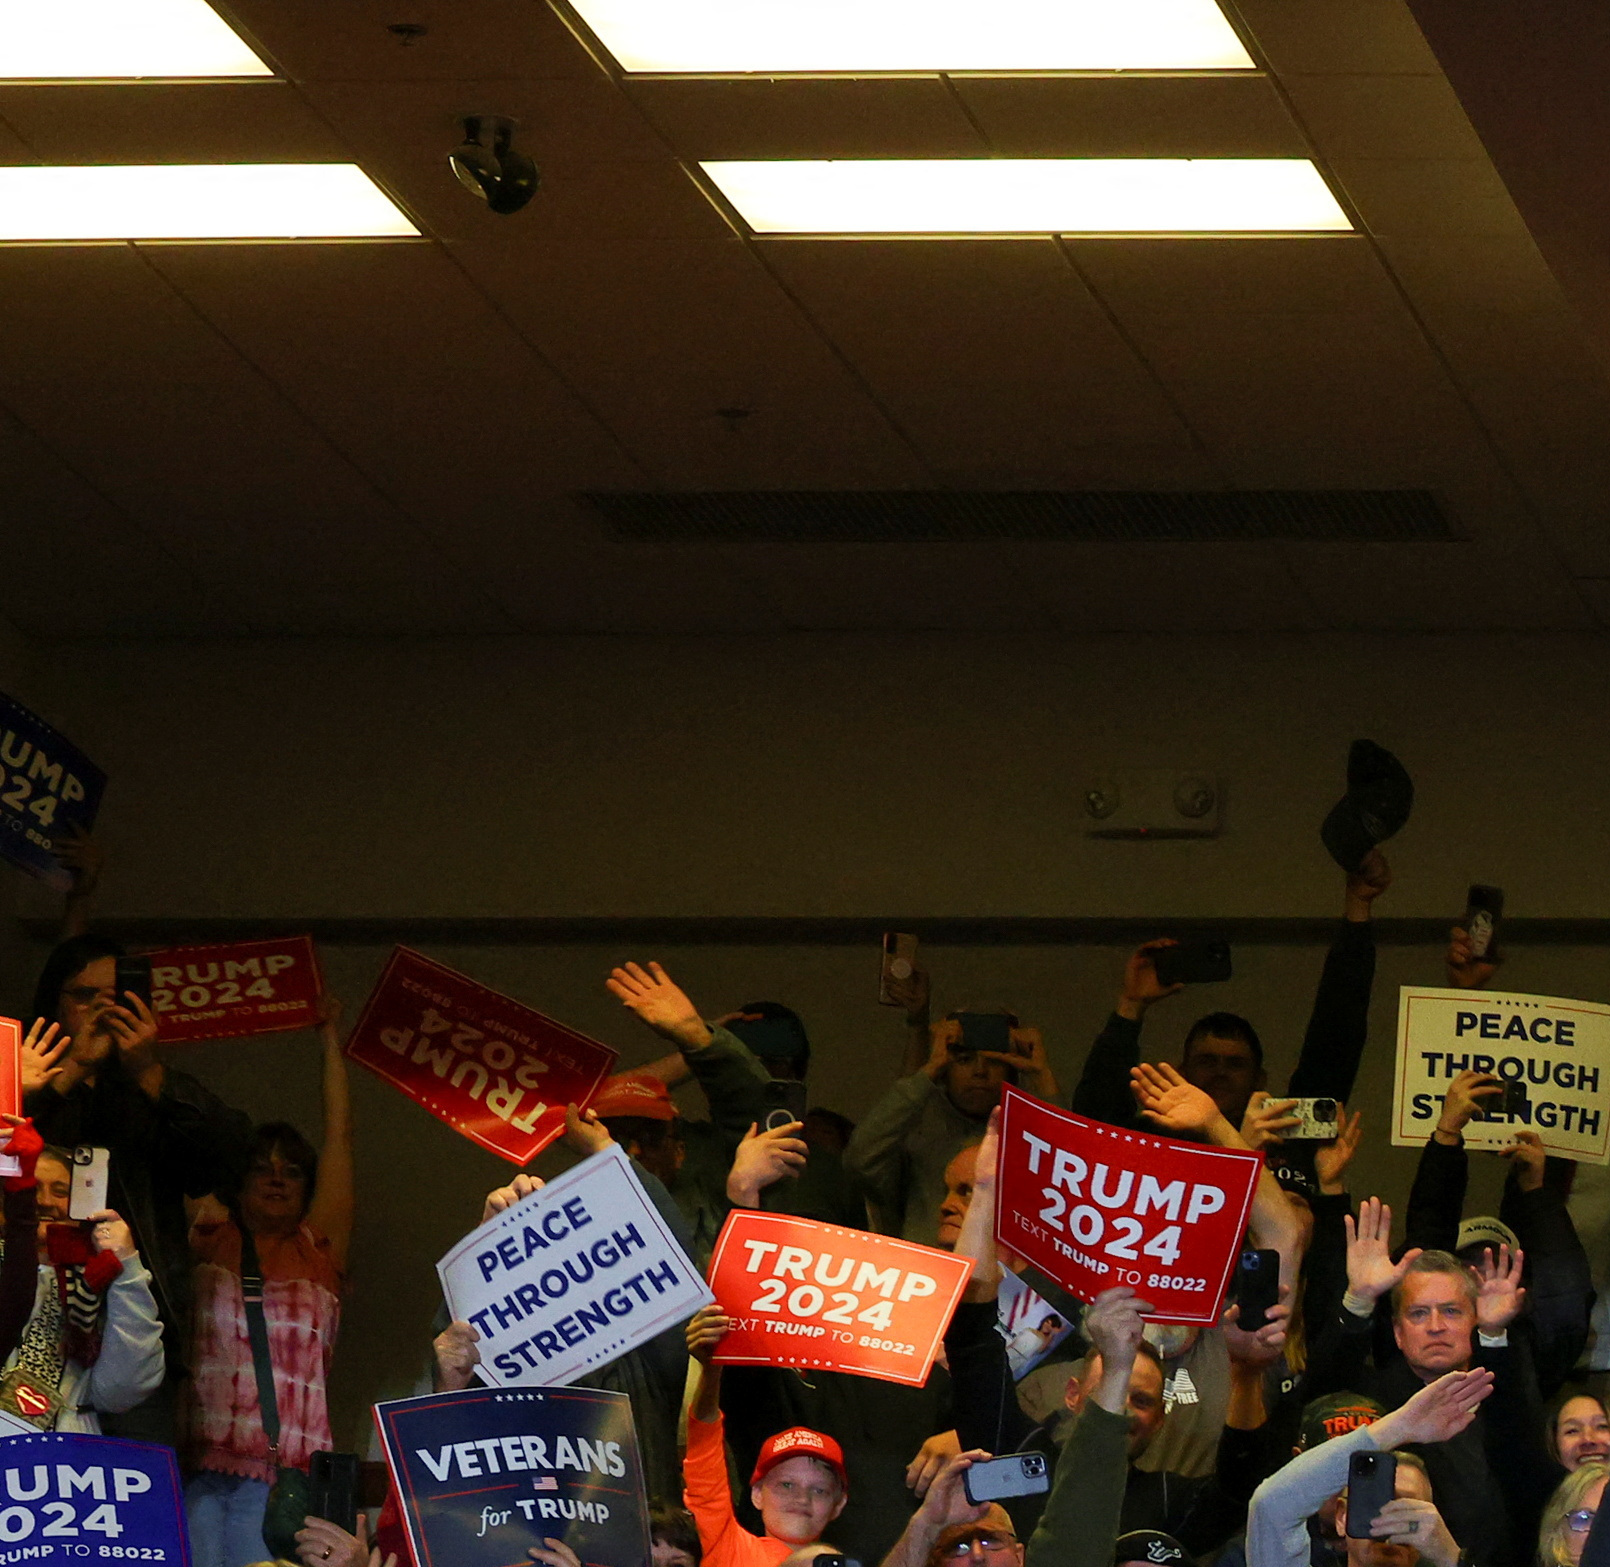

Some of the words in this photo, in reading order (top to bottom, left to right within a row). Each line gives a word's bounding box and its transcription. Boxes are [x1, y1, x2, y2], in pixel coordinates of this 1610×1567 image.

[151, 977, 275, 1012] 2024
[168, 1008, 226, 1024] TRUMP
[233, 1004, 251, 1016] TO
[258, 1000, 308, 1014] 88022
[421, 1007, 549, 1089] 2024
[483, 1017, 538, 1050] TRUMP
[1456, 1011, 1576, 1047] PEACE
[380, 1026, 547, 1136] TRUMP
[1020, 1130, 1226, 1225] TRUMP
[475, 1195, 593, 1284] PEACE
[1012, 1208, 1051, 1244] TEXT
[1052, 1238, 1110, 1277] TRUMP
[1114, 1265, 1143, 1287] TO
[1146, 1272, 1207, 1293] 88022
[1038, 1189, 1182, 1266] 2024
[469, 1222, 648, 1339] THROUGH
[744, 1239, 937, 1303] TRUMP
[493, 1260, 680, 1378] STRENGTH
[751, 1278, 893, 1333] 2024
[764, 1320, 825, 1339] TRUMP
[831, 1328, 854, 1344] TO
[859, 1335, 915, 1357] 88022
[415, 1435, 626, 1483] VETERANS
[477, 1505, 512, 1537] for
[516, 1498, 610, 1525] TRUMP
[61, 1544, 91, 1557] TO
[98, 1545, 166, 1561] 88022
